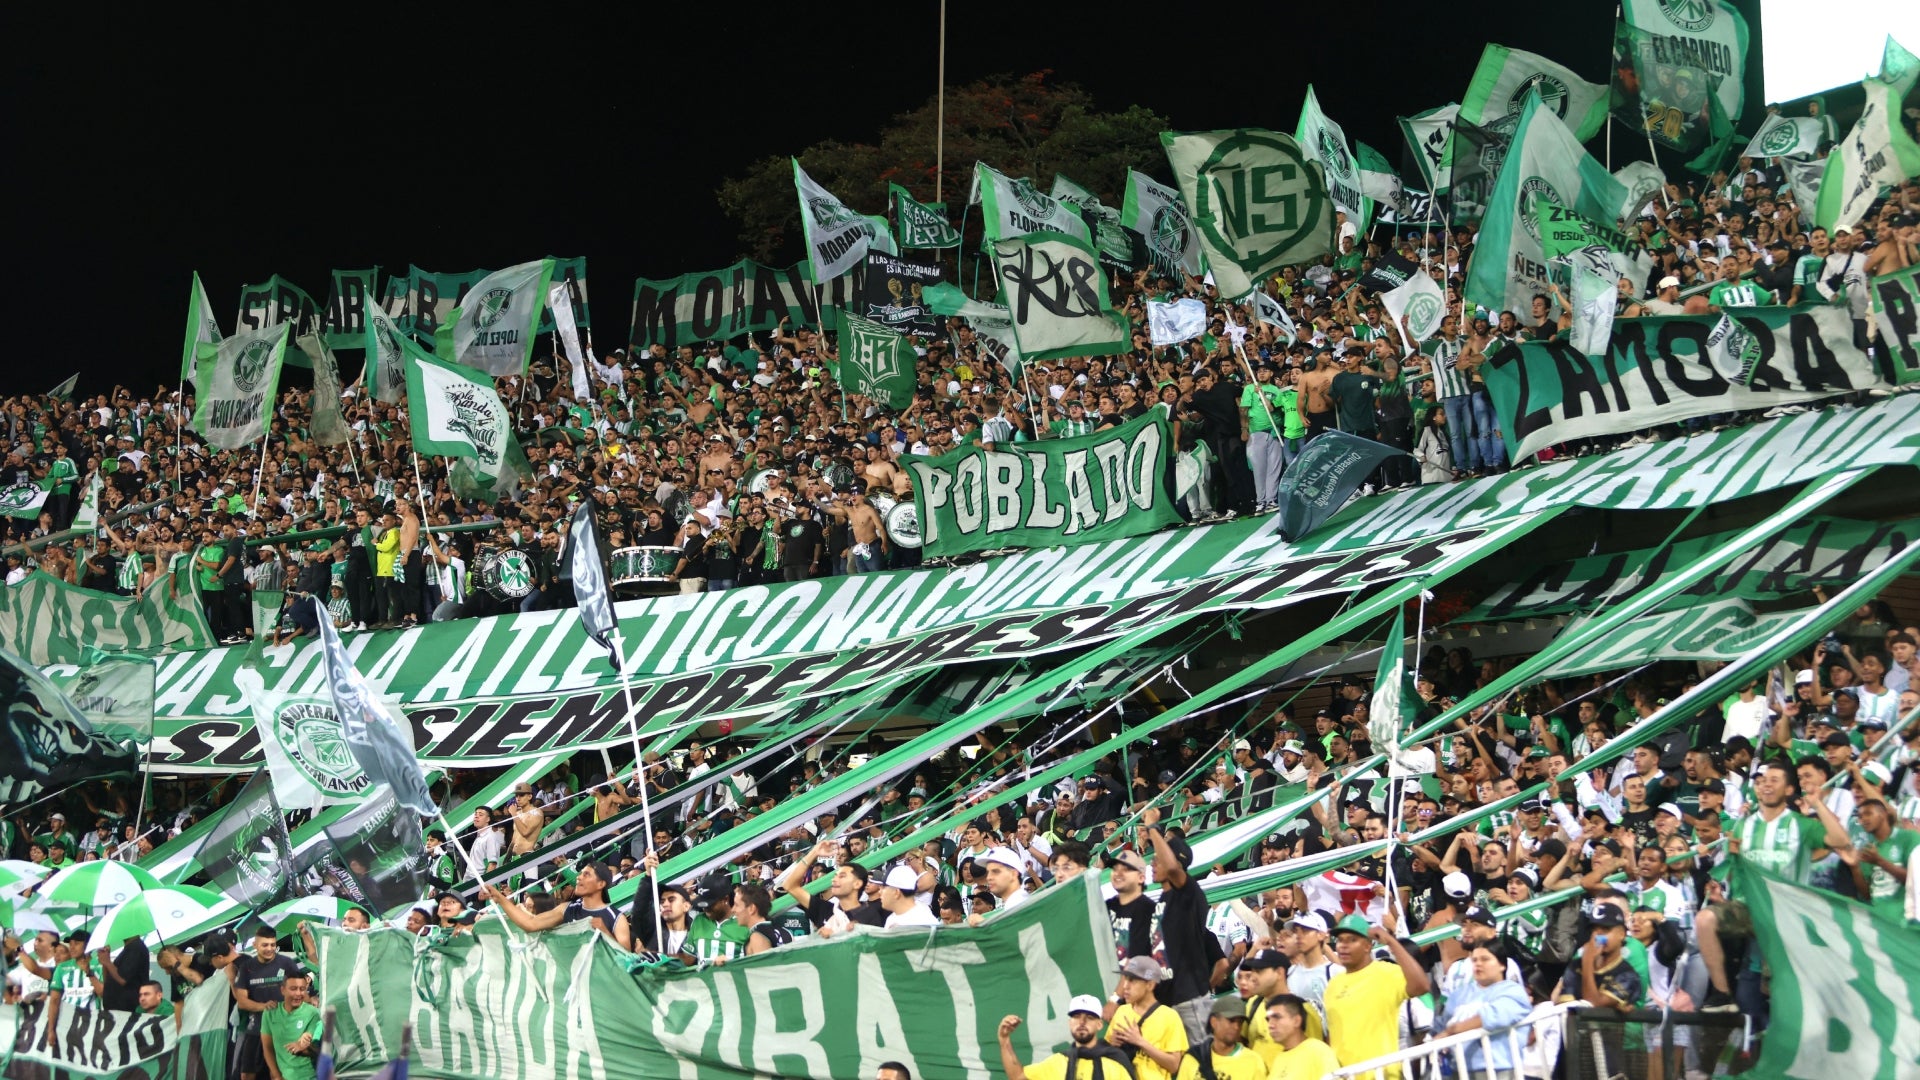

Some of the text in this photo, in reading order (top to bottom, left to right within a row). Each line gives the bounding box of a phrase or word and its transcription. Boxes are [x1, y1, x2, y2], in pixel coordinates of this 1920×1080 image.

[1670, 35, 1732, 76] CARMELO
[1549, 206, 1640, 262] ZAORA
[1553, 231, 1586, 242] DESDE
[1494, 312, 1853, 442] ZAMORA
[910, 421, 1162, 546] POBLADO
[402, 580, 822, 703] ATLETICO
[798, 524, 1215, 653] NACIONAL
[1312, 462, 1573, 554] MAS
[411, 652, 838, 757] SIEMPRE
[803, 527, 1489, 695] PRESENTES
[363, 797, 395, 834] BARRIO
[14, 1000, 169, 1071] BARRIO
[652, 921, 1076, 1080] PIRATA
